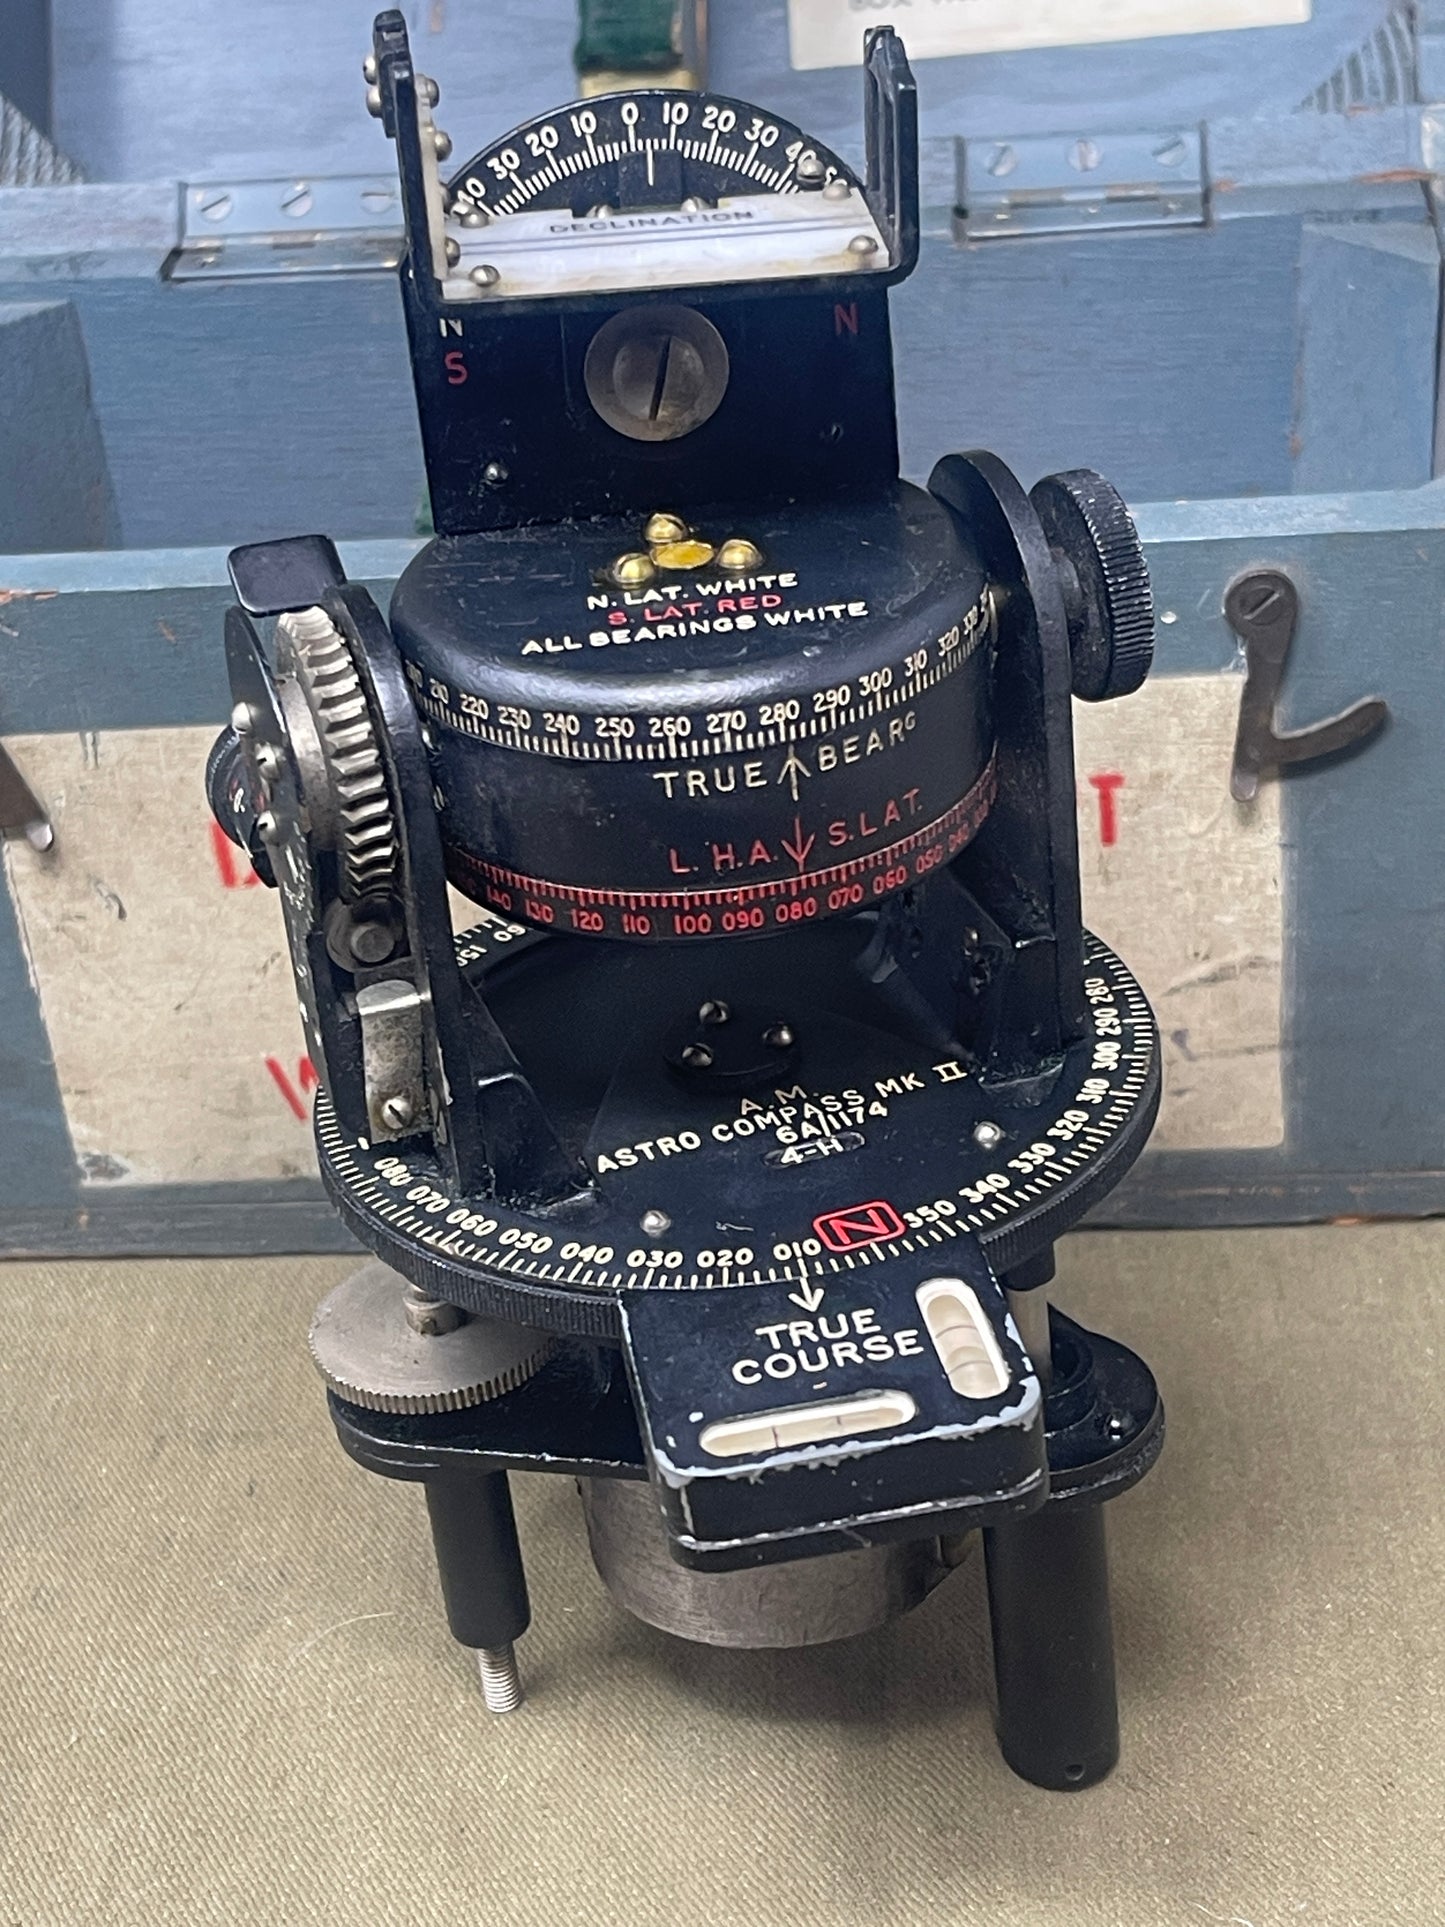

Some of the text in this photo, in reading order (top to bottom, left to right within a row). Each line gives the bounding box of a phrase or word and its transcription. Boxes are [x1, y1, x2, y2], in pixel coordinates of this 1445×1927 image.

[487, 149, 520, 180] 30
[525, 125, 559, 157] 20
[570, 110, 597, 137] 10
[621, 102, 639, 126] 0
[662, 101, 689, 125] 10
[702, 105, 736, 132] 20
[744, 118, 779, 147] 30
[549, 210, 754, 234] DECLINATION
[439, 318, 463, 338] N
[834, 303, 859, 336] N
[443, 352, 469, 386] S
[587, 572, 799, 610] N. LAT. WHITE
[717, 594, 782, 613] RED
[521, 602, 869, 656] ALL BEARINGS WHITE
[460, 693, 489, 720] 220
[497, 706, 531, 731] 230
[543, 713, 580, 736] 240
[594, 717, 635, 738] 250
[648, 716, 691, 738] 260
[706, 710, 747, 734] 270
[758, 700, 800, 726] 280
[812, 685, 850, 713] 290
[858, 667, 893, 697] 300
[904, 649, 928, 677] 310
[937, 625, 960, 657] 320
[653, 761, 768, 798] TRUE
[525, 899, 554, 923] 130
[570, 908, 604, 932] 120
[622, 913, 651, 934] 110
[673, 913, 713, 934] 100
[721, 908, 765, 931] 090
[775, 897, 818, 923] 080
[828, 884, 863, 910] 070
[872, 866, 908, 895] 060
[915, 843, 944, 874] 050
[373, 977, 1122, 1269] 080 070 060 050 040 030 020 010 N 350 340 330 320 310 300 290 280
[597, 1061, 968, 1175] ASTRO COMPASS MK II
[775, 1101, 889, 1145] 6A/1174
[780, 1138, 845, 1165] 4-H
[755, 1308, 882, 1352] TRUE
[731, 1329, 924, 1385] COURSE
